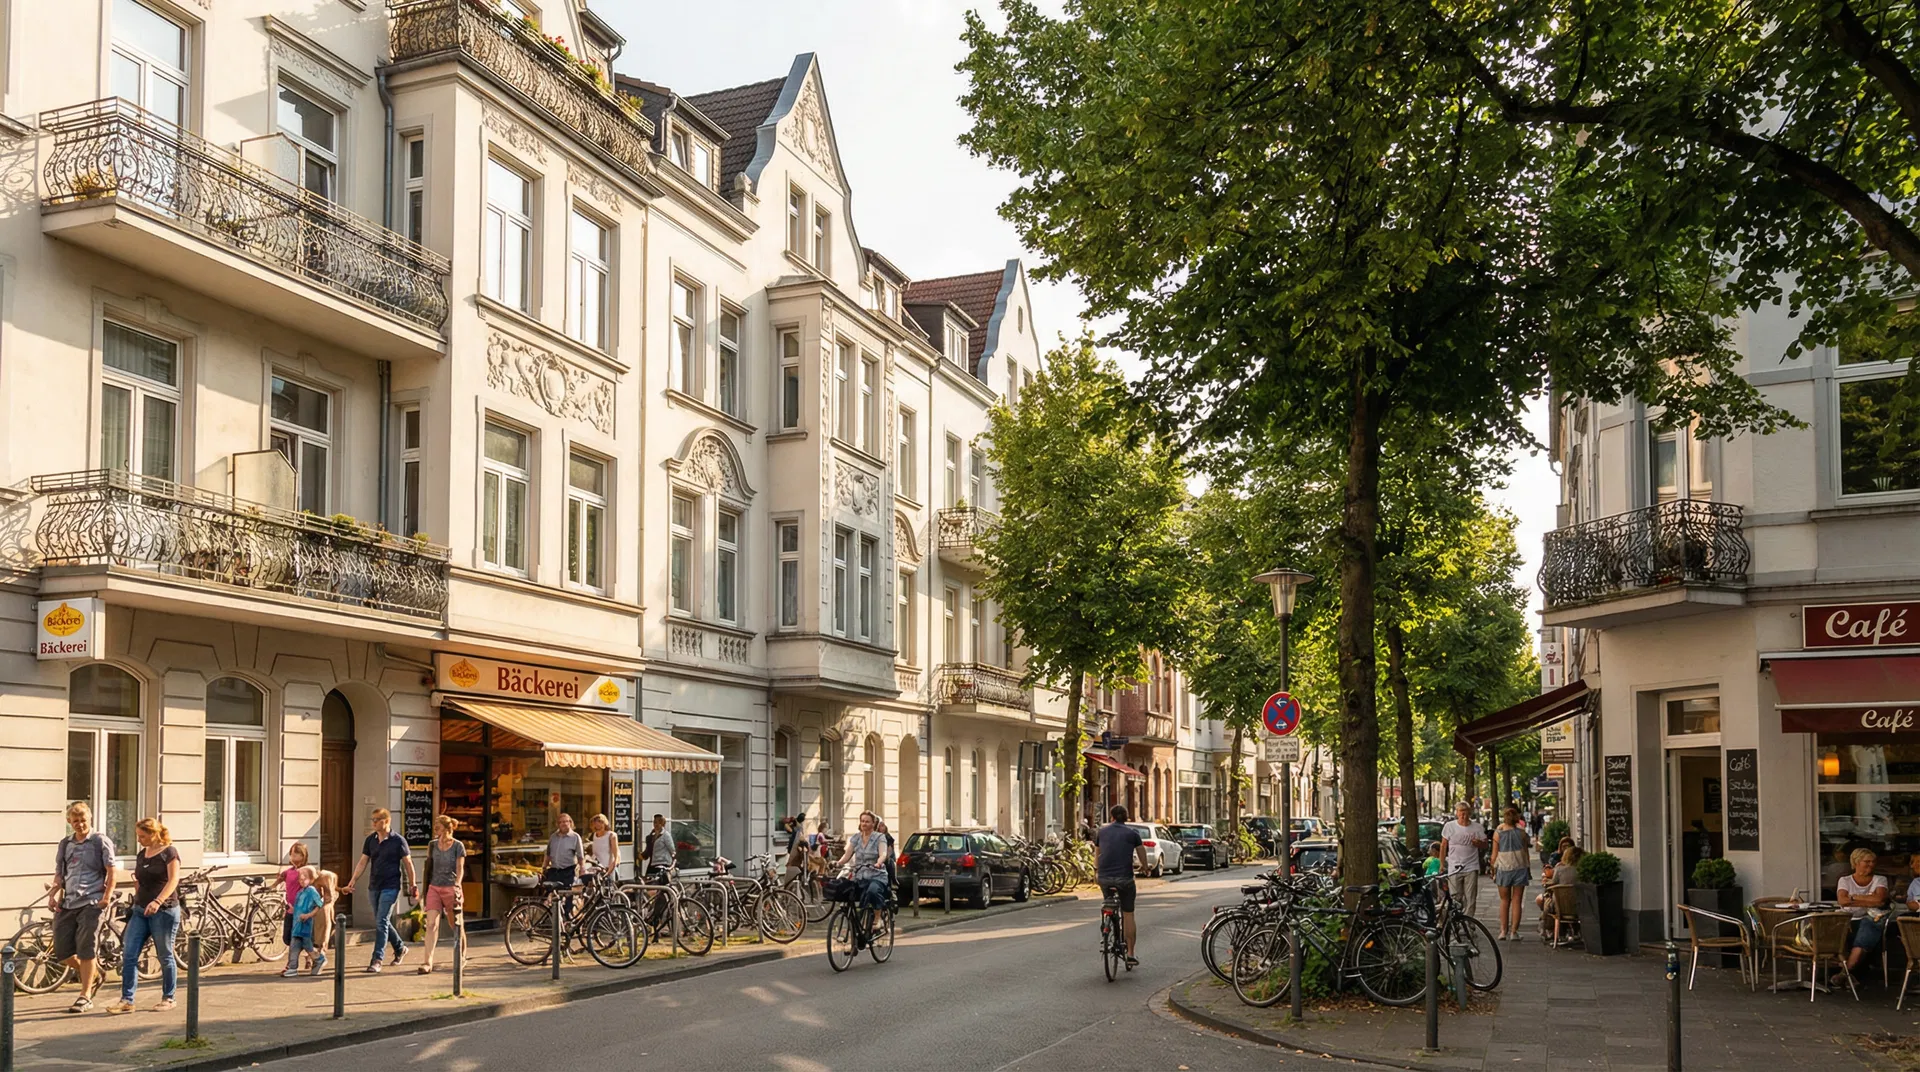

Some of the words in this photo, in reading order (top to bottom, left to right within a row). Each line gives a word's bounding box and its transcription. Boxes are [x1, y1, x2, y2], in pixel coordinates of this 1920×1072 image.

[1825, 608, 1908, 645] Café
[40, 639, 87, 655] Bäckerei
[497, 666, 579, 699] Bäckerei
[1861, 709, 1914, 734] Café
